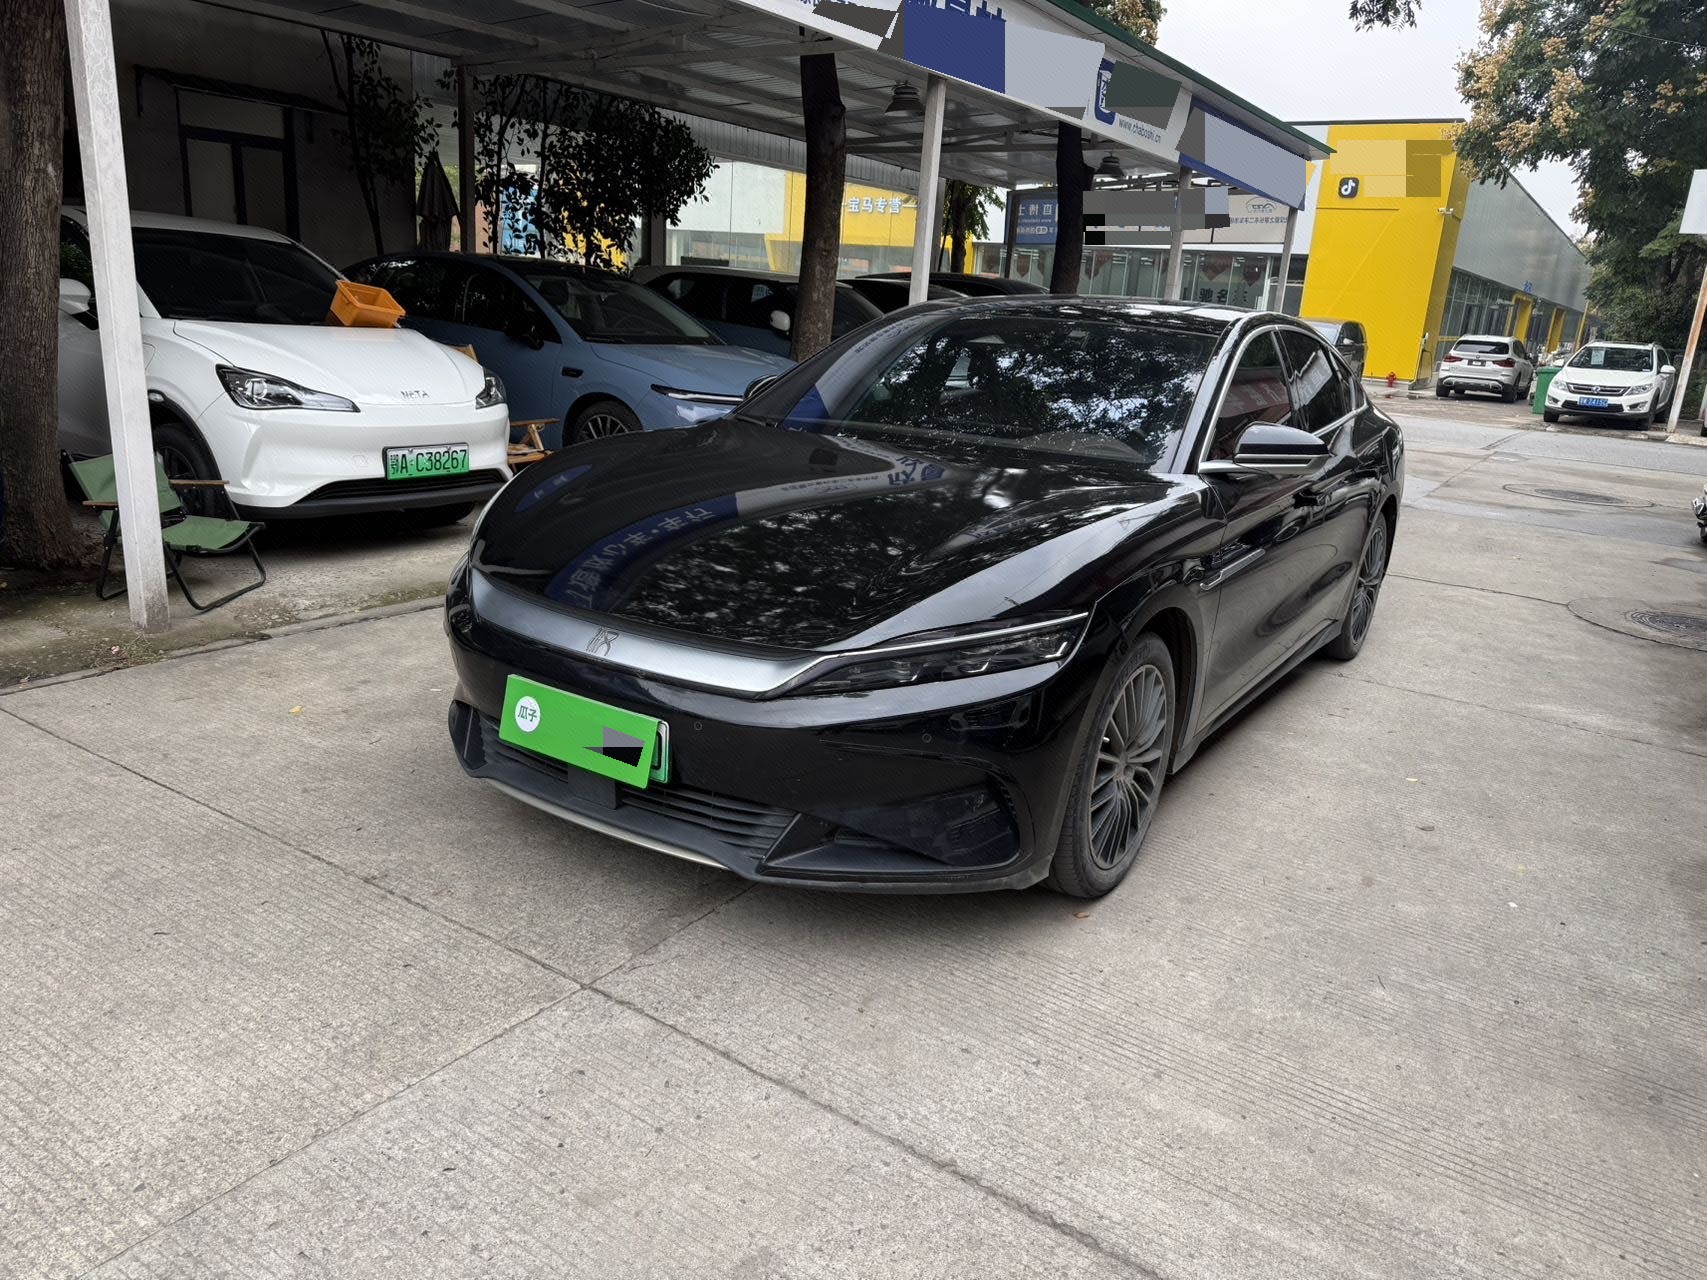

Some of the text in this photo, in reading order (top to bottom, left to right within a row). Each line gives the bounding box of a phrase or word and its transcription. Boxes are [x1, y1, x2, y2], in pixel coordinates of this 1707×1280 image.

[847, 197, 902, 214] 宝马专营
[517, 705, 538, 719] 瓜子
